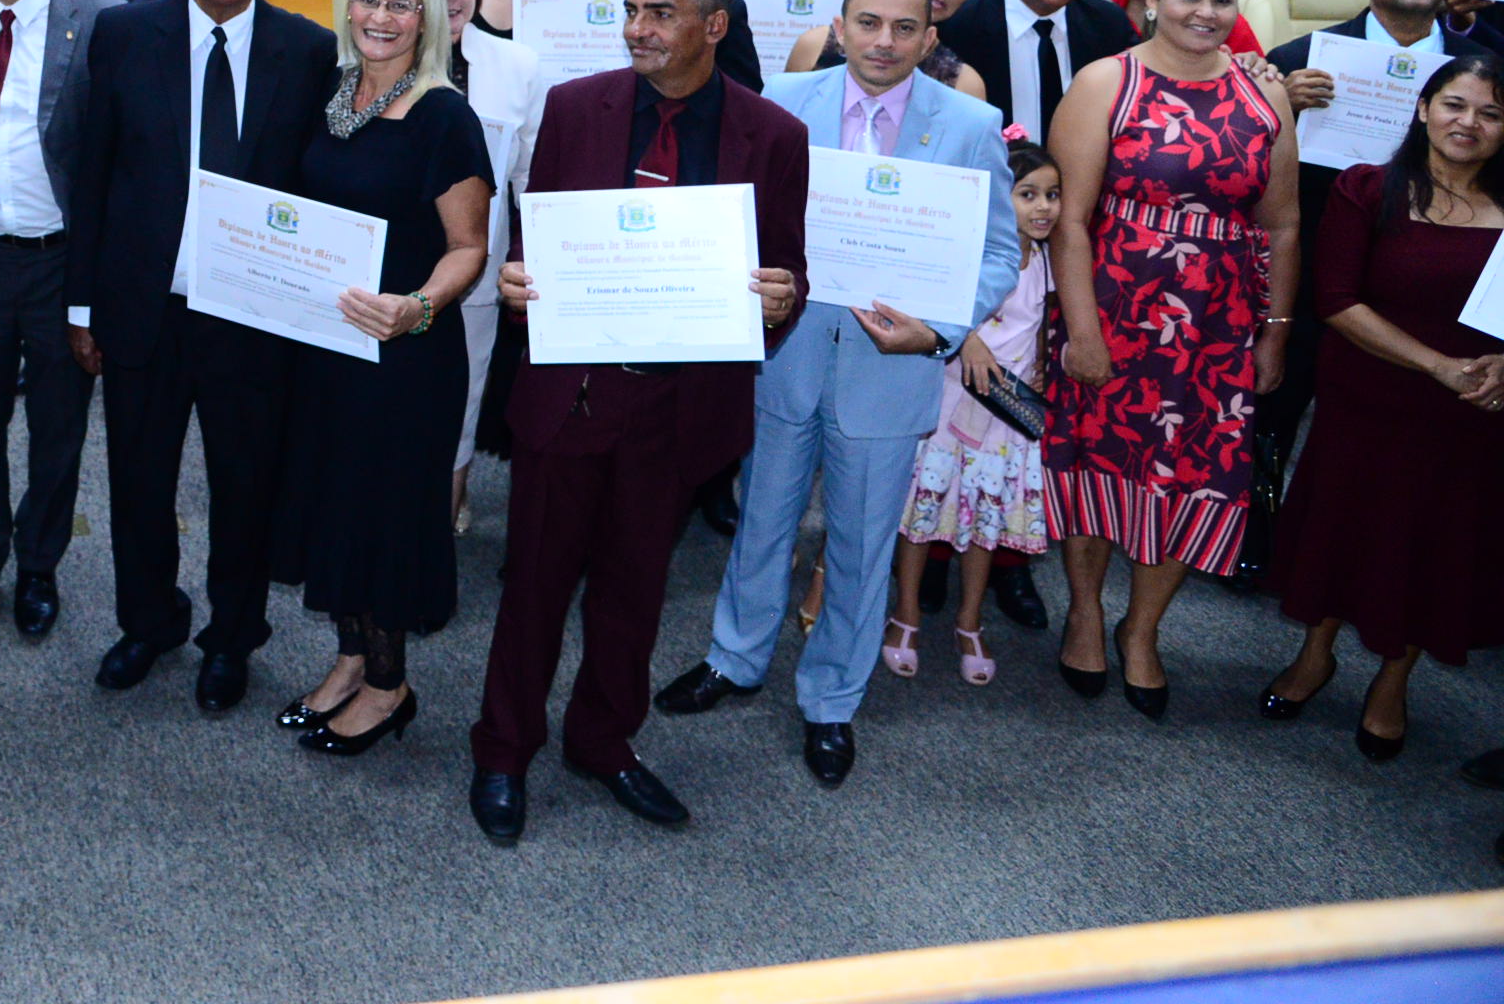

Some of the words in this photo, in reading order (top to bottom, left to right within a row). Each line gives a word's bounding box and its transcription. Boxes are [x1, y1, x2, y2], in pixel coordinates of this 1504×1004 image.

[810, 191, 848, 205] Diploma
[853, 196, 862, 206] de
[868, 200, 898, 212] Honra
[903, 205, 913, 213] ao
[918, 206, 951, 219] Mérito
[218, 218, 253, 237] Diploma
[256, 230, 266, 241] de
[270, 233, 297, 252] Honra
[301, 245, 311, 254] ao
[315, 246, 347, 265] Mérito
[561, 240, 605, 252] Diploma
[609, 239, 619, 250] de
[624, 239, 658, 250] Honra
[662, 239, 675, 248] ao
[679, 237, 716, 247] Mérito
[860, 240, 881, 249] Costa
[661, 285, 695, 293] Oliveira
